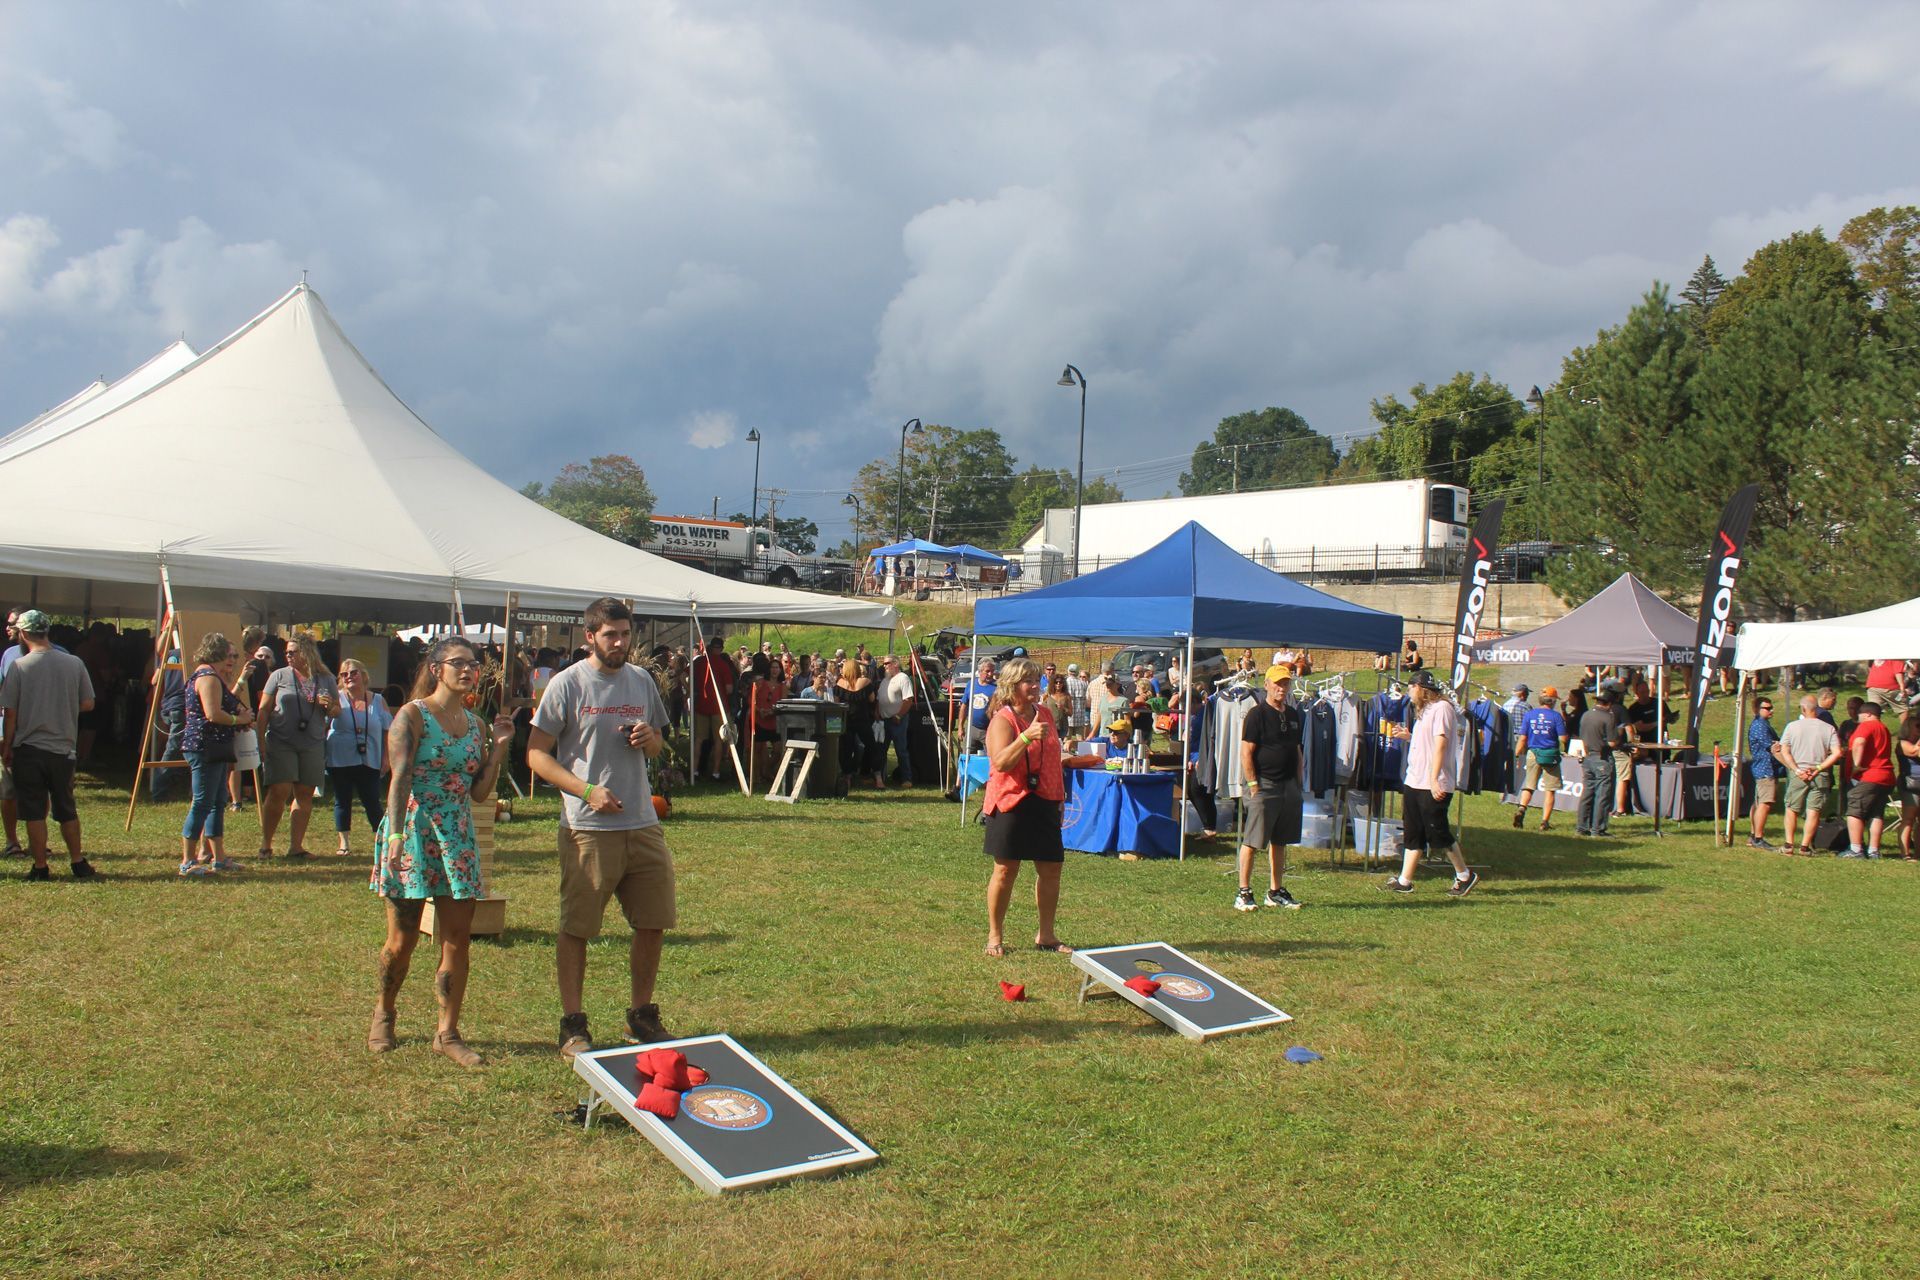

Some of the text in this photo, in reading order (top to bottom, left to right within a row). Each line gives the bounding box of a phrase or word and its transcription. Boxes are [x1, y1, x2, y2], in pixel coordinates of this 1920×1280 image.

[654, 523, 730, 540] POOL WATER
[665, 537, 717, 548] 543-3571
[517, 612, 575, 624] CLAREMONT
[1453, 559, 1492, 690] erizon
[1476, 647, 1530, 663] verizon
[1668, 647, 1695, 664] veriz
[580, 704, 645, 717] PowerSeal
